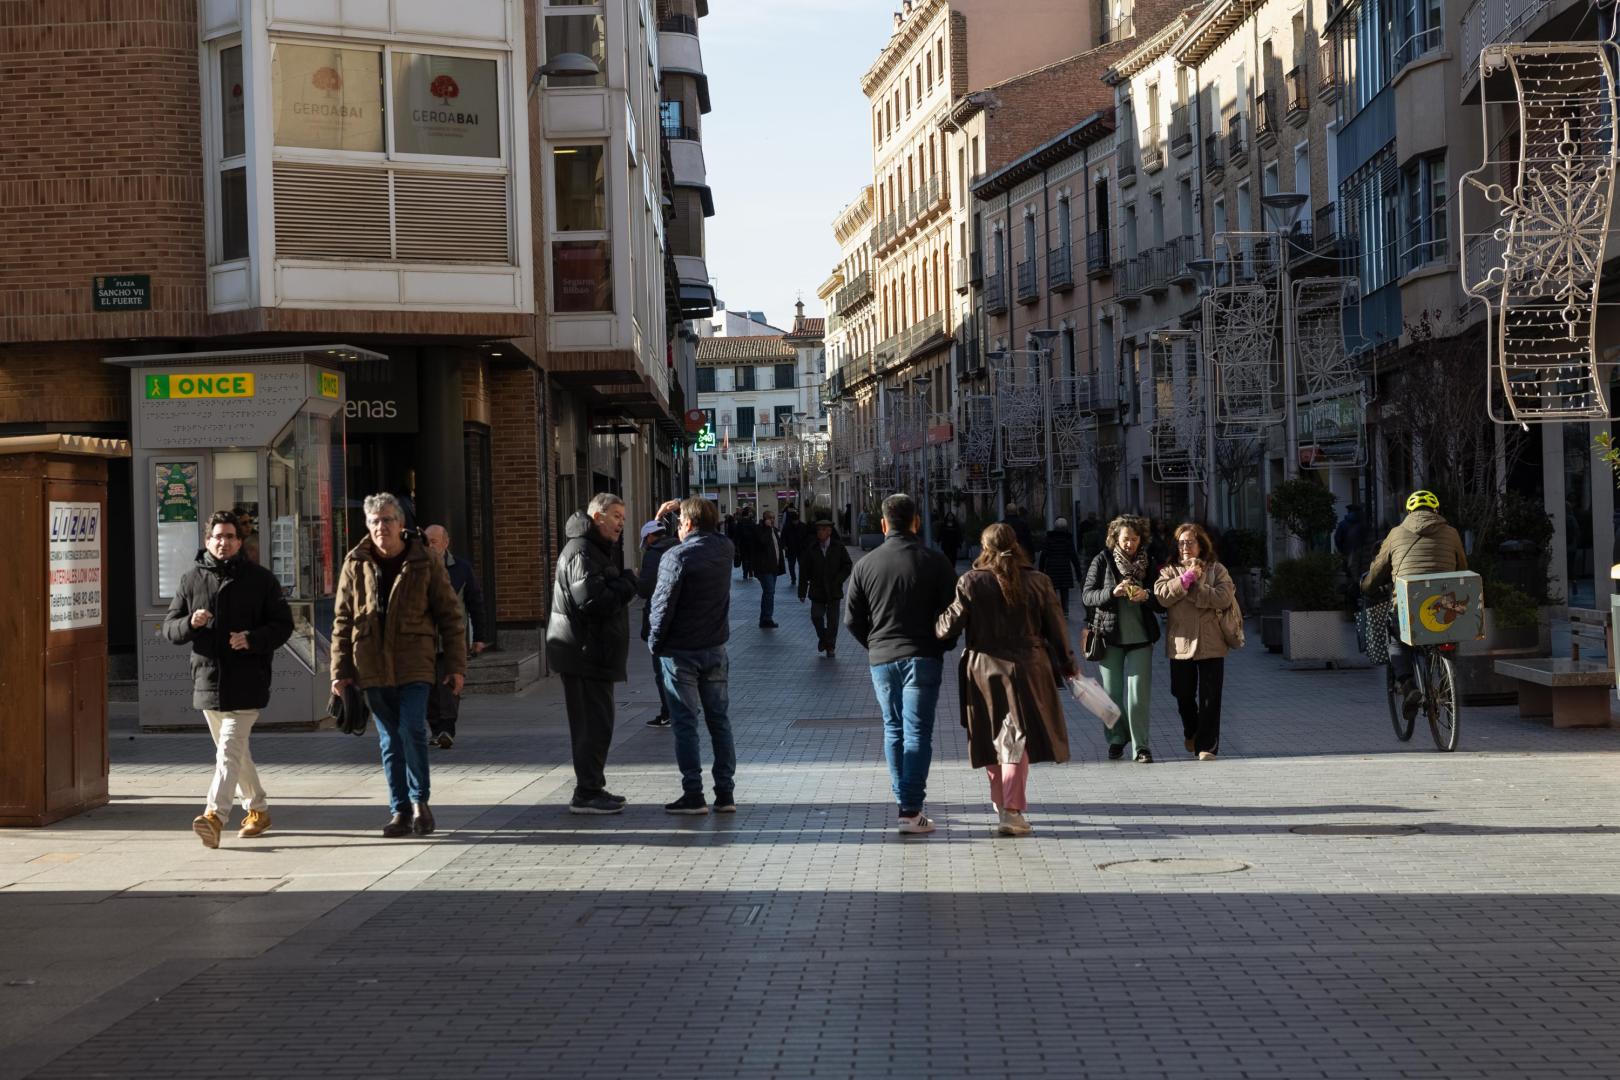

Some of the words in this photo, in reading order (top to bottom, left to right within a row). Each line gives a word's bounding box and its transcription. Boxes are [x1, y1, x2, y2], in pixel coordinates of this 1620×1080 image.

[293, 102, 363, 118] GEROABAI
[412, 109, 479, 125] GEROABAI
[98, 288, 131, 297] SANCHO
[132, 288, 145, 296] VII
[100, 297, 111, 305] EL
[112, 297, 143, 305] FUERTE
[178, 377, 246, 395] ONCE
[323, 376, 337, 394] ONCE
[52, 515, 97, 536] LIZAR
